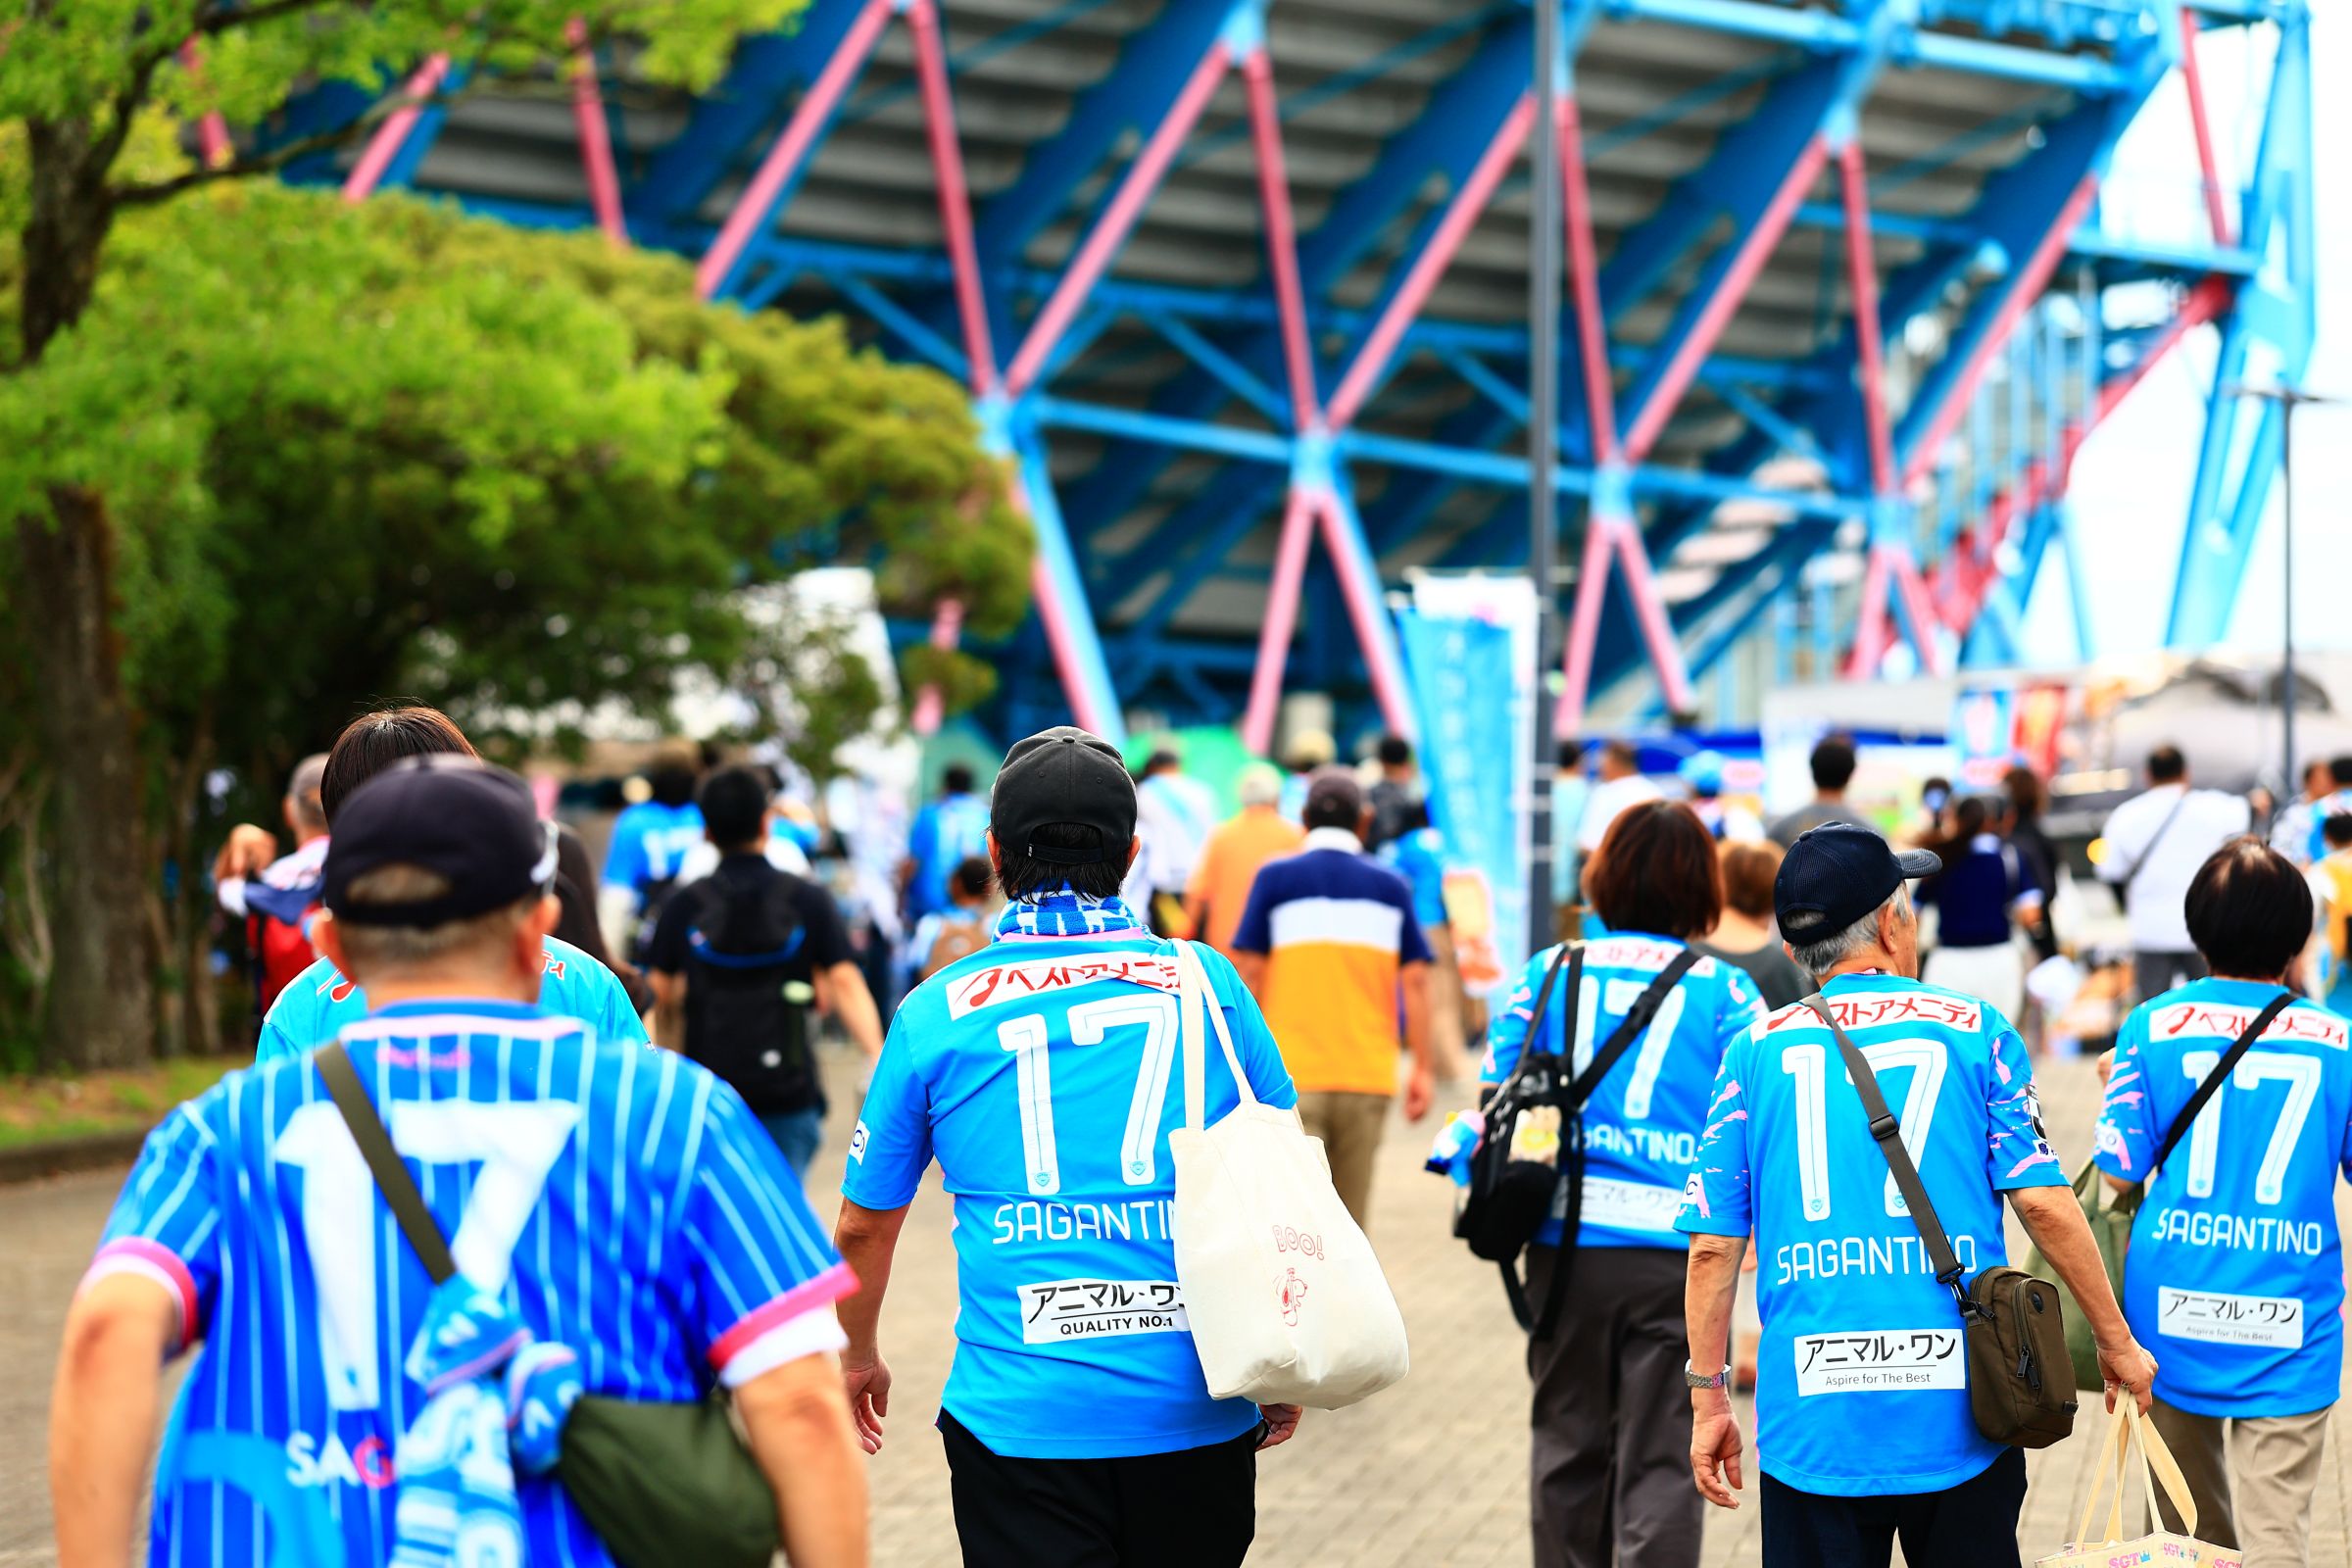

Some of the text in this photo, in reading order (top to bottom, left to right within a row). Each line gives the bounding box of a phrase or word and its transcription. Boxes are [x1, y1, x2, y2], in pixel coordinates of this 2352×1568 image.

[998, 993, 1179, 1196] 17
[1782, 1038, 1948, 1222] 17
[2181, 1050, 2322, 1205] 17
[1272, 1224, 1324, 1260] BOO!
[2152, 1207, 2323, 1256] SAGANTINO
[275, 1098, 581, 1410] 17
[1060, 1315, 1173, 1335] QUALITY NO.1
[2164, 1292, 2296, 1324] アニマル・ワン
[1802, 1334, 1956, 1374] アニマル・ワン
[1826, 1372, 1932, 1387] Aspire for The Best
